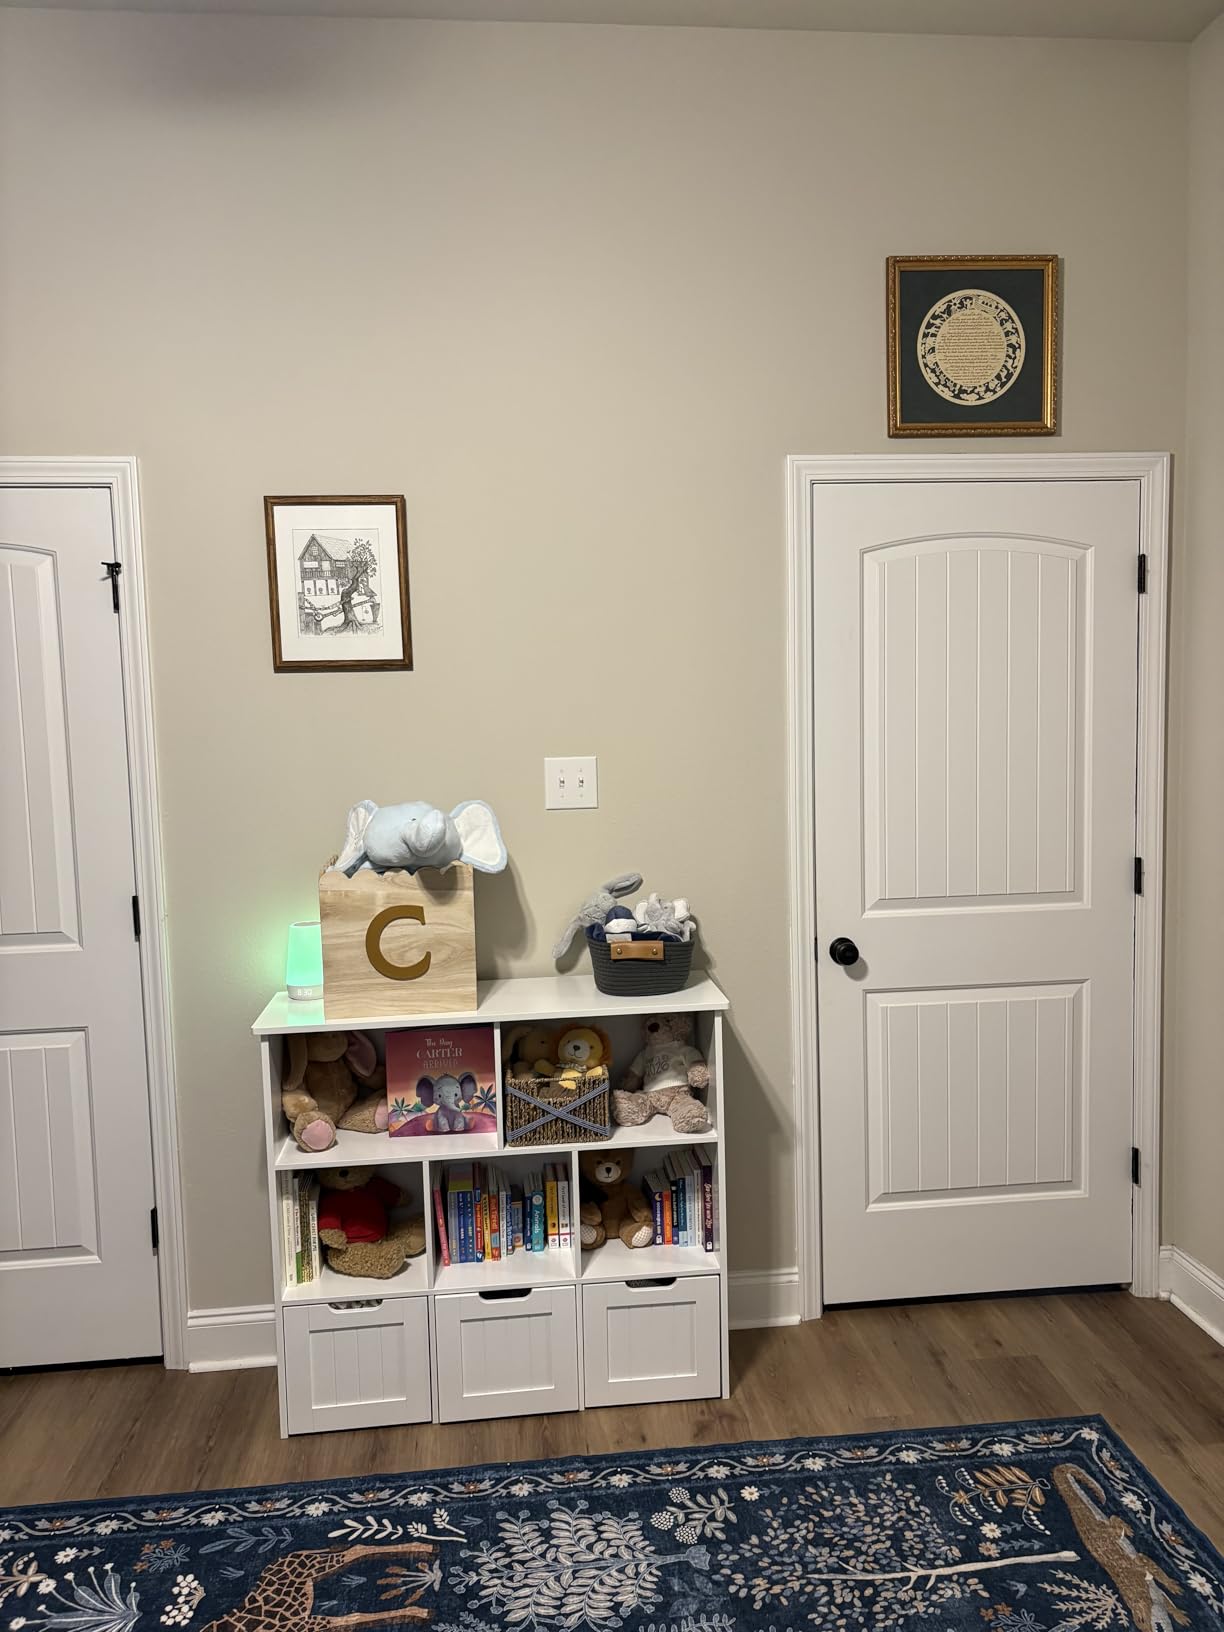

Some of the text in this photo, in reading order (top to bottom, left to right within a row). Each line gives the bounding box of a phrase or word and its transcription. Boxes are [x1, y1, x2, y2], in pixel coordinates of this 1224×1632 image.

[366, 905, 431, 981] C
[424, 1037, 437, 1048] The
[416, 1047, 463, 1059] CARTER
